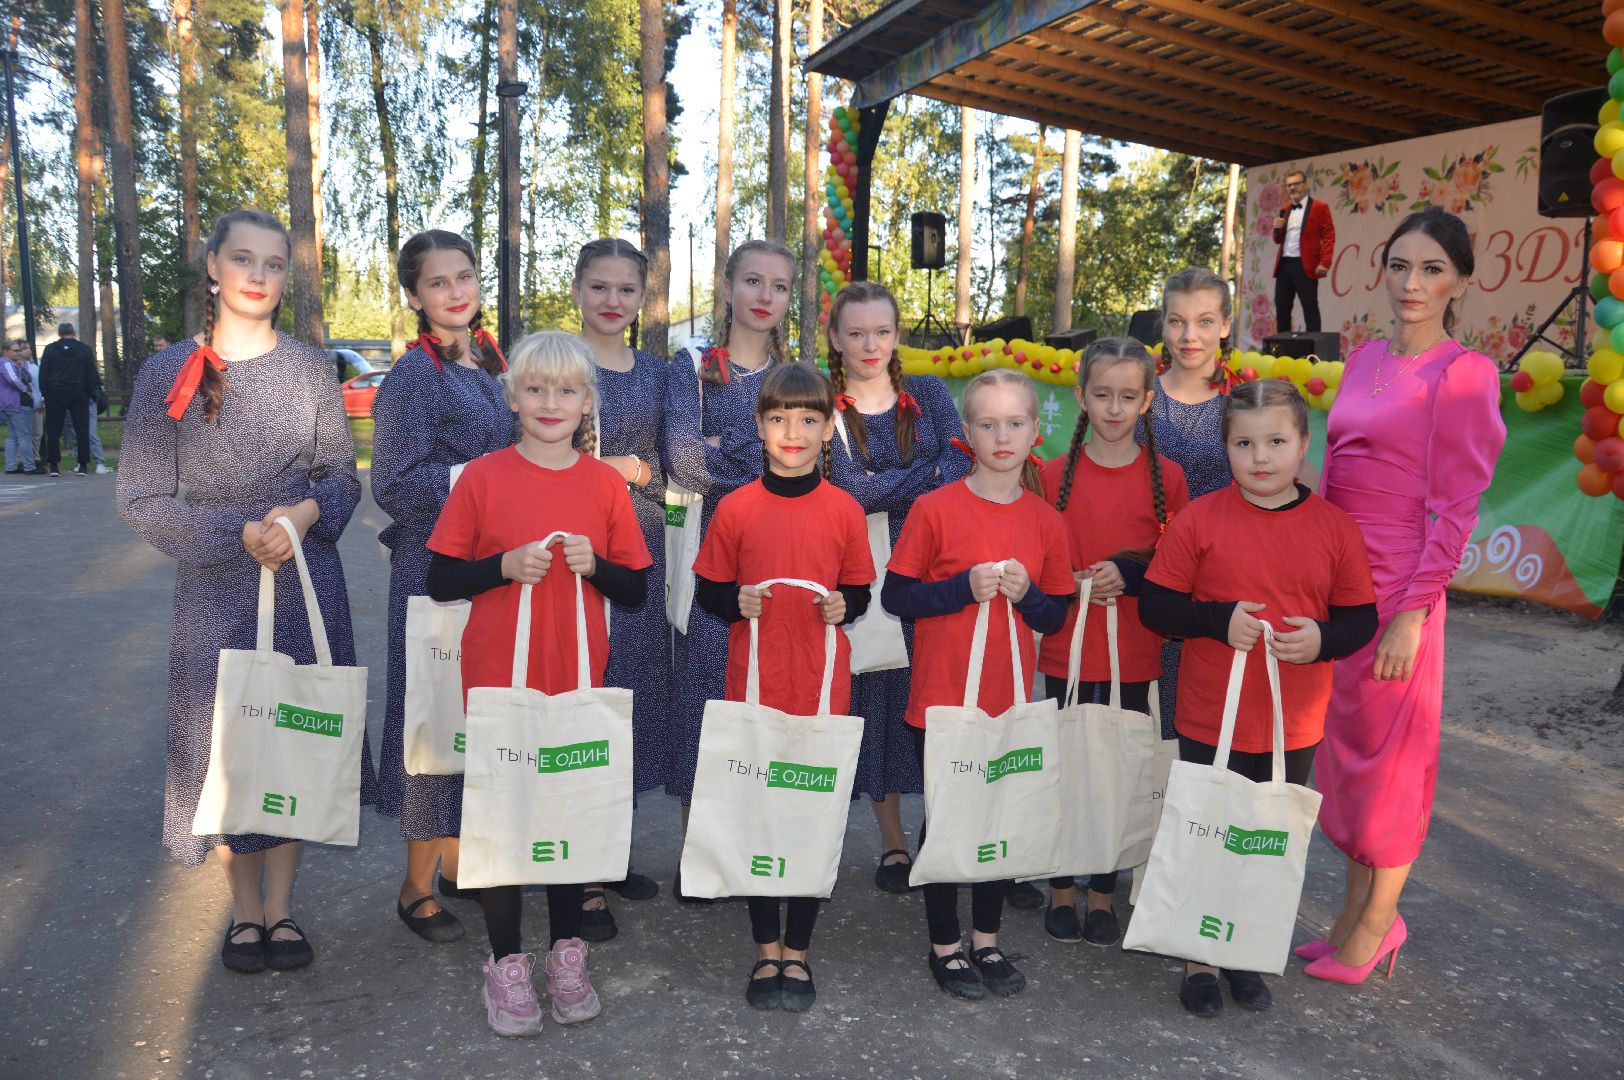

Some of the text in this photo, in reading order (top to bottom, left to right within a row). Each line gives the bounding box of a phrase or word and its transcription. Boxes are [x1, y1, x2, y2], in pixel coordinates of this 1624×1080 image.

[430, 647, 452, 661] ТЫ
[240, 704, 342, 733] ТЫ НЕ ОДИН
[496, 746, 608, 768] ТЫ НЕ ОДИН
[950, 753, 1042, 779] ТЫ НЕ ОДИН
[727, 759, 836, 788] ТЫ НЕ ОДИН
[1187, 820, 1287, 852] ТЫ НЕ ОДИН
